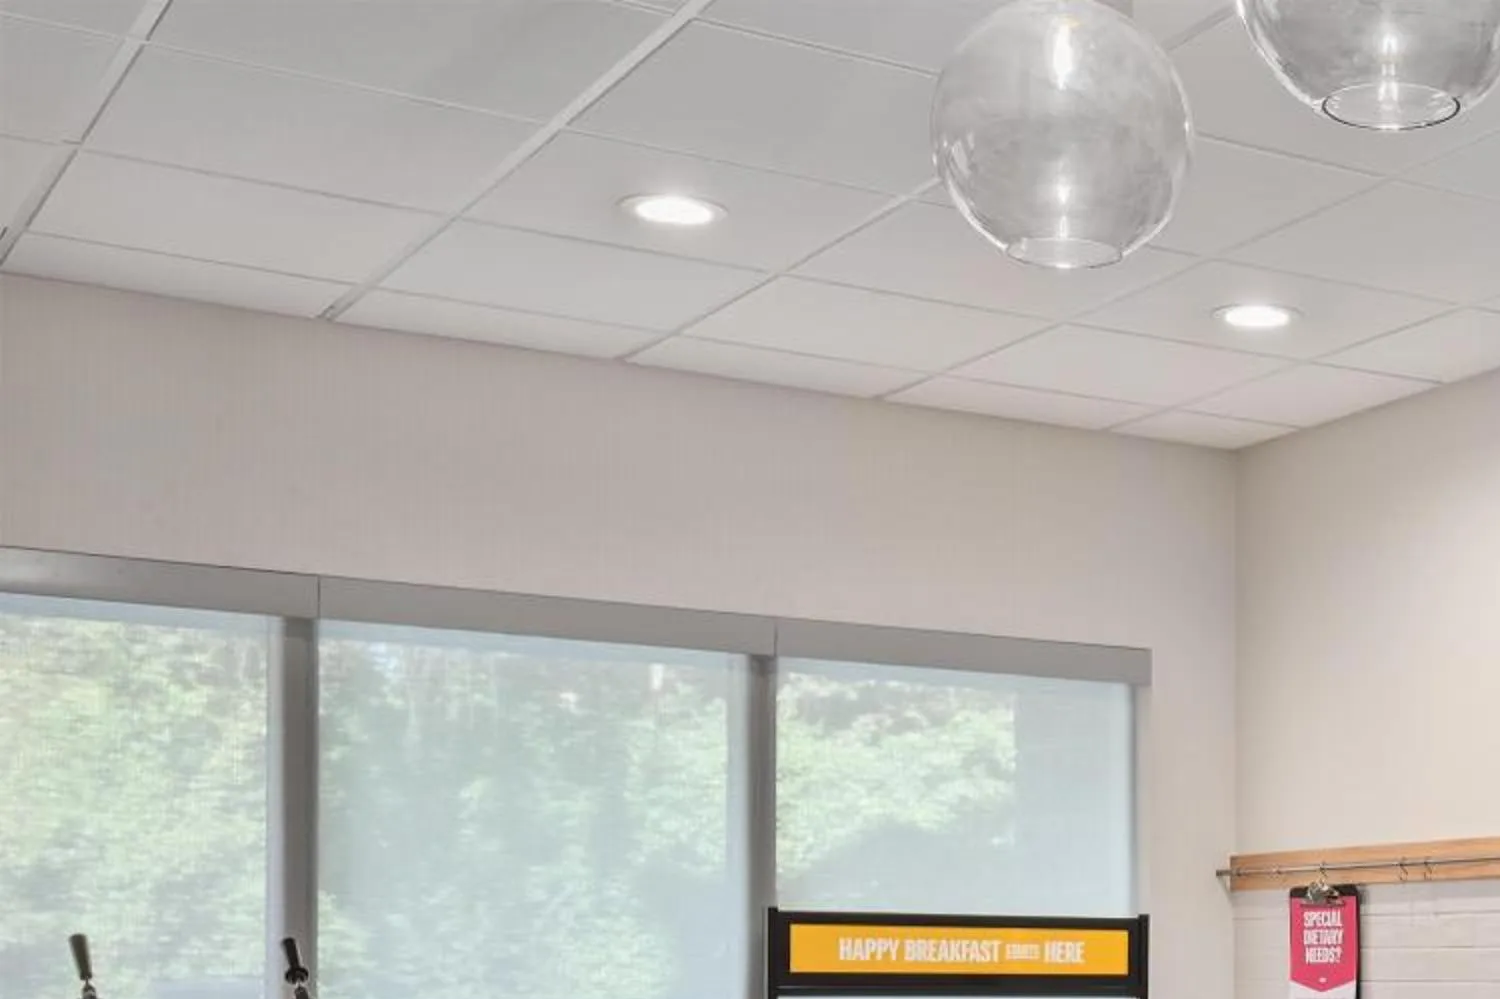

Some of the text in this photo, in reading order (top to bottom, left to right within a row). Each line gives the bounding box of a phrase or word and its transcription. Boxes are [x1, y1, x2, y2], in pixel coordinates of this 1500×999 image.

[1303, 911, 1343, 927] SPECIAL
[1303, 929, 1344, 945] DIETARY
[839, 937, 899, 961] HAPPY
[904, 939, 1002, 963] BREAKFAST
[1044, 941, 1085, 963] HERE
[1305, 947, 1343, 963] NEEDS?
